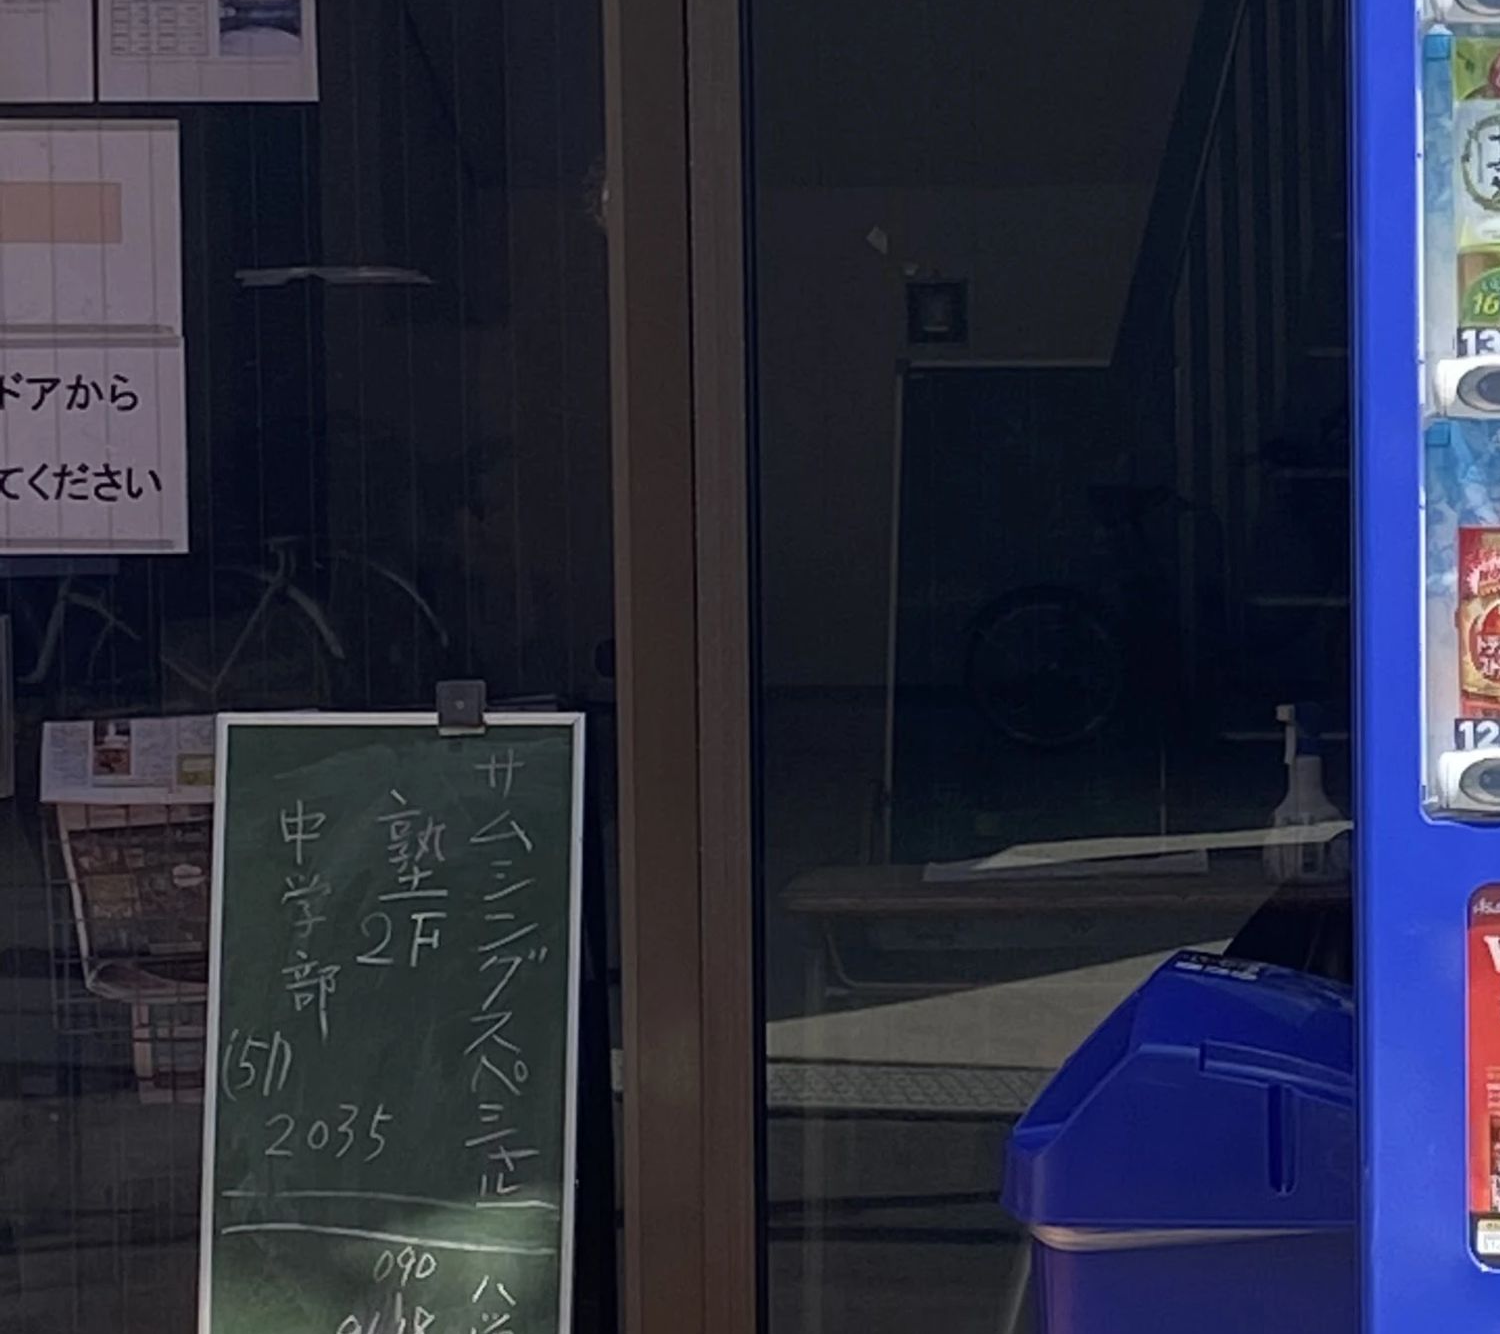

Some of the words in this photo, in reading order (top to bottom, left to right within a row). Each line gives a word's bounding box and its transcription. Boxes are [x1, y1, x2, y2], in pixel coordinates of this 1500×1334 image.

[280, 798, 341, 1043] 中学部
[356, 912, 448, 968] 2F
[264, 1103, 393, 1162] 2035
[375, 1246, 437, 1287] 090
